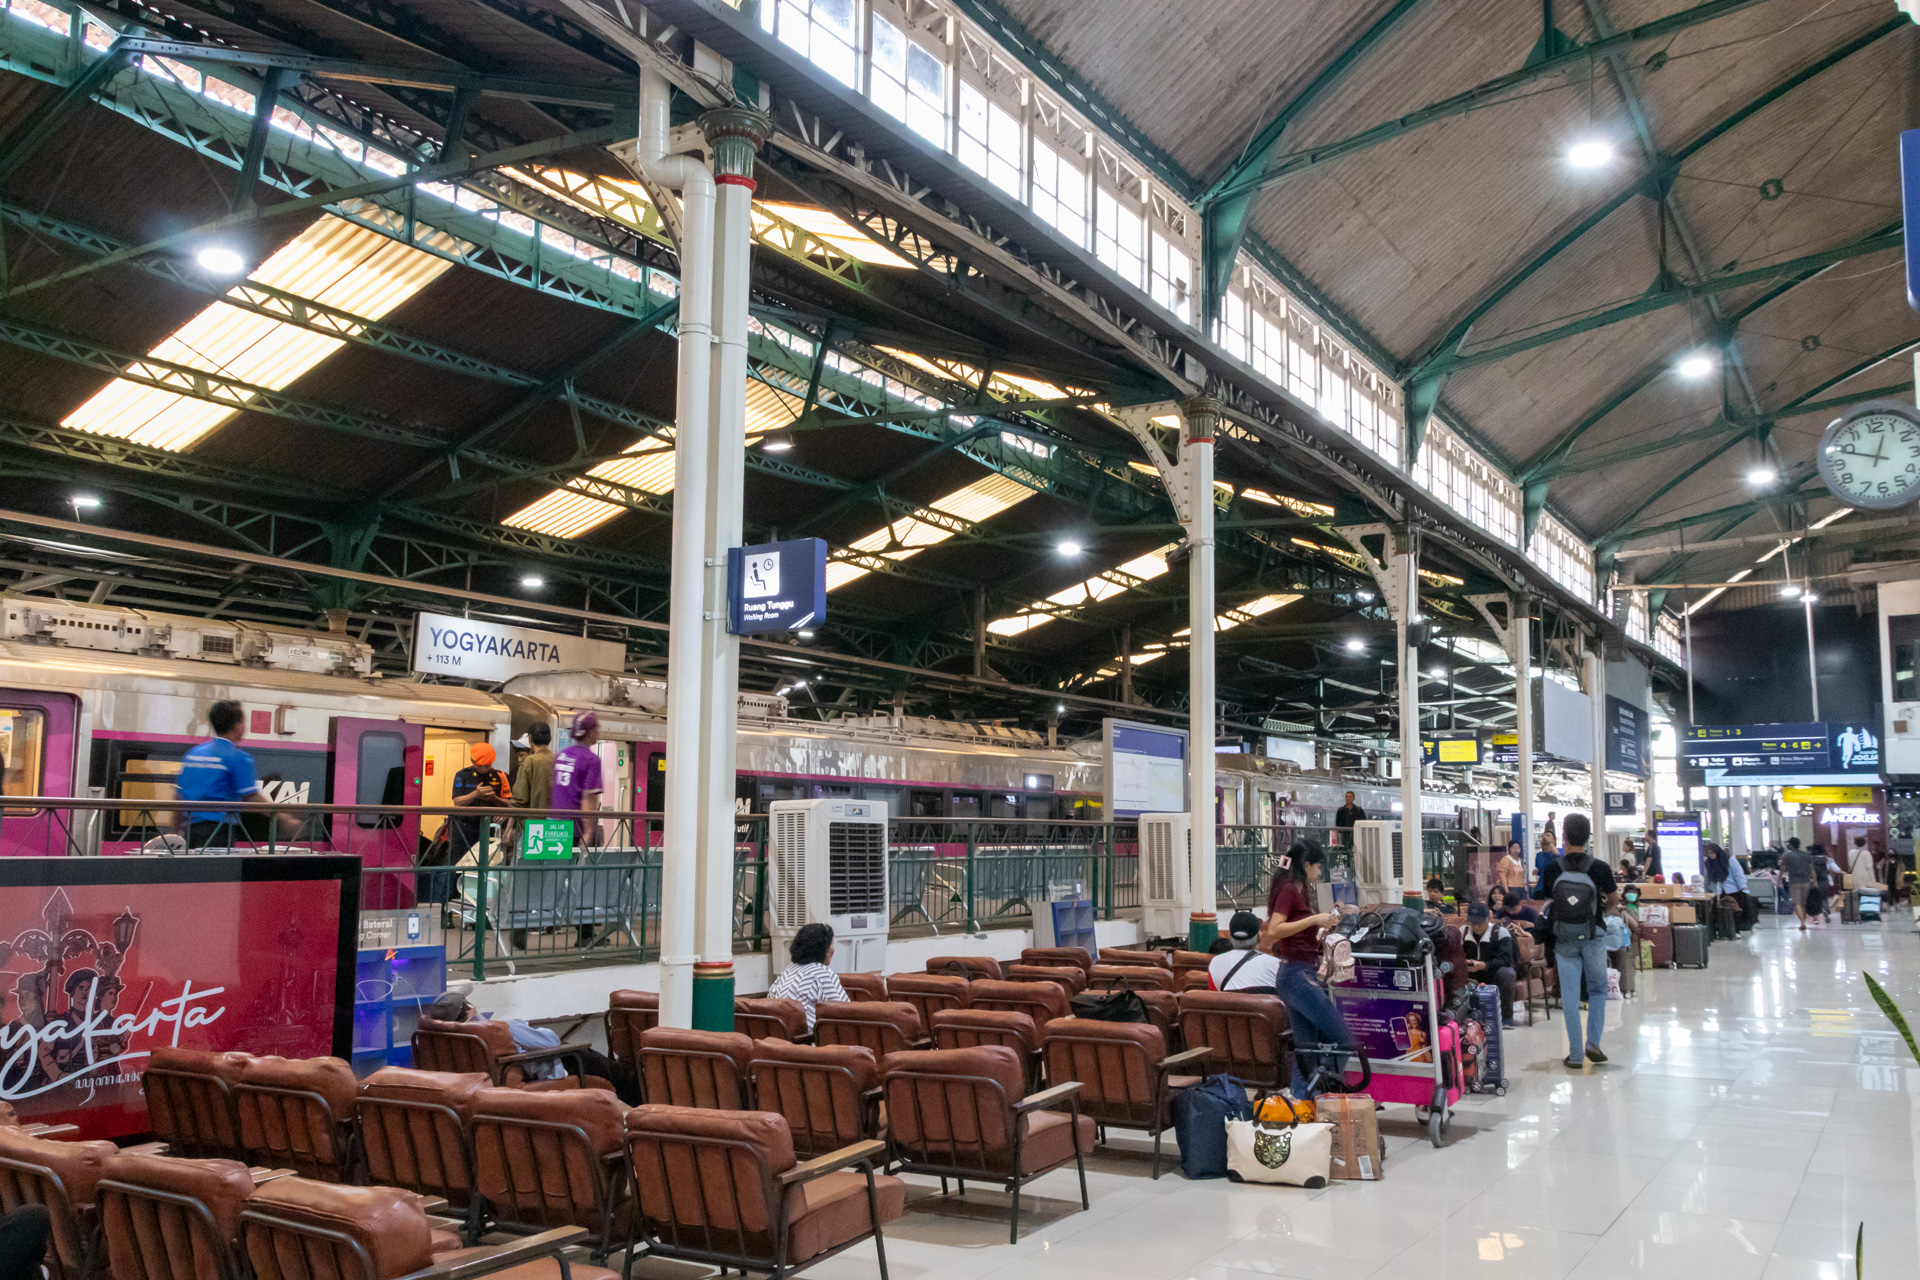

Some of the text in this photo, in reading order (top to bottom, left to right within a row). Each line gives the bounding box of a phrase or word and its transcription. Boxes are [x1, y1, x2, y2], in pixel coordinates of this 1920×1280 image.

[1865, 421, 1884, 434] 12
[1889, 422, 1895, 433] 1
[1849, 430, 1860, 441] 11
[1899, 430, 1913, 443] 2
[1909, 445, 1920, 458] 3
[1834, 458, 1846, 471] 9
[1905, 463, 1916, 474] 4
[1841, 472, 1854, 484] 8
[1894, 475, 1909, 488] 5
[1860, 481, 1873, 493] 7
[1877, 481, 1889, 493] 6
[744, 600, 795, 612] Ruang Tunggu
[744, 613, 763, 621] Waiting
[430, 627, 560, 664] YOGYAKARTA
[436, 654, 450, 664] 113
[452, 656, 462, 666] M
[557, 771, 571, 786] 13
[255, 780, 310, 804] KAI
[366, 930, 391, 939] Corner
